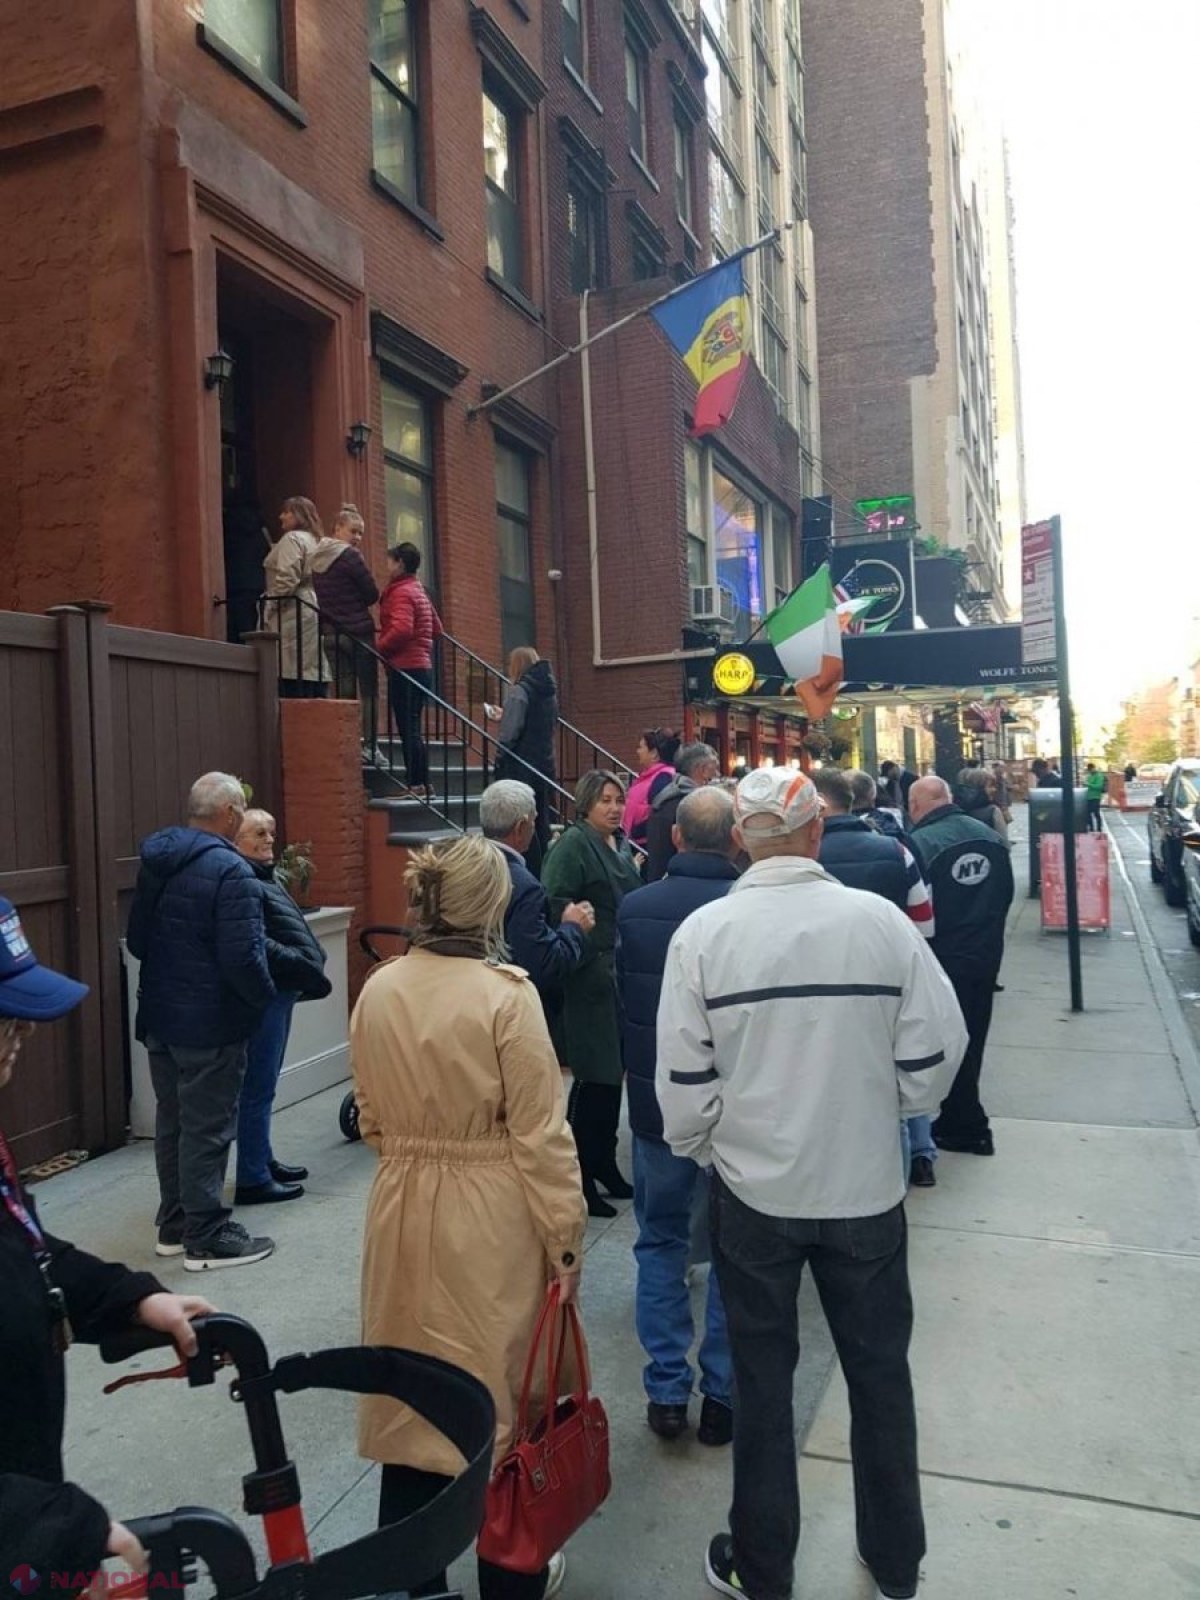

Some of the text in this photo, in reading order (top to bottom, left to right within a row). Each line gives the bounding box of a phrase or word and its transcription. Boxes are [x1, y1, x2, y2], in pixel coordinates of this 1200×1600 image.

[720, 670, 748, 680] HARP
[980, 664, 1058, 678] WOLFE TONES
[958, 859, 985, 879] NY
